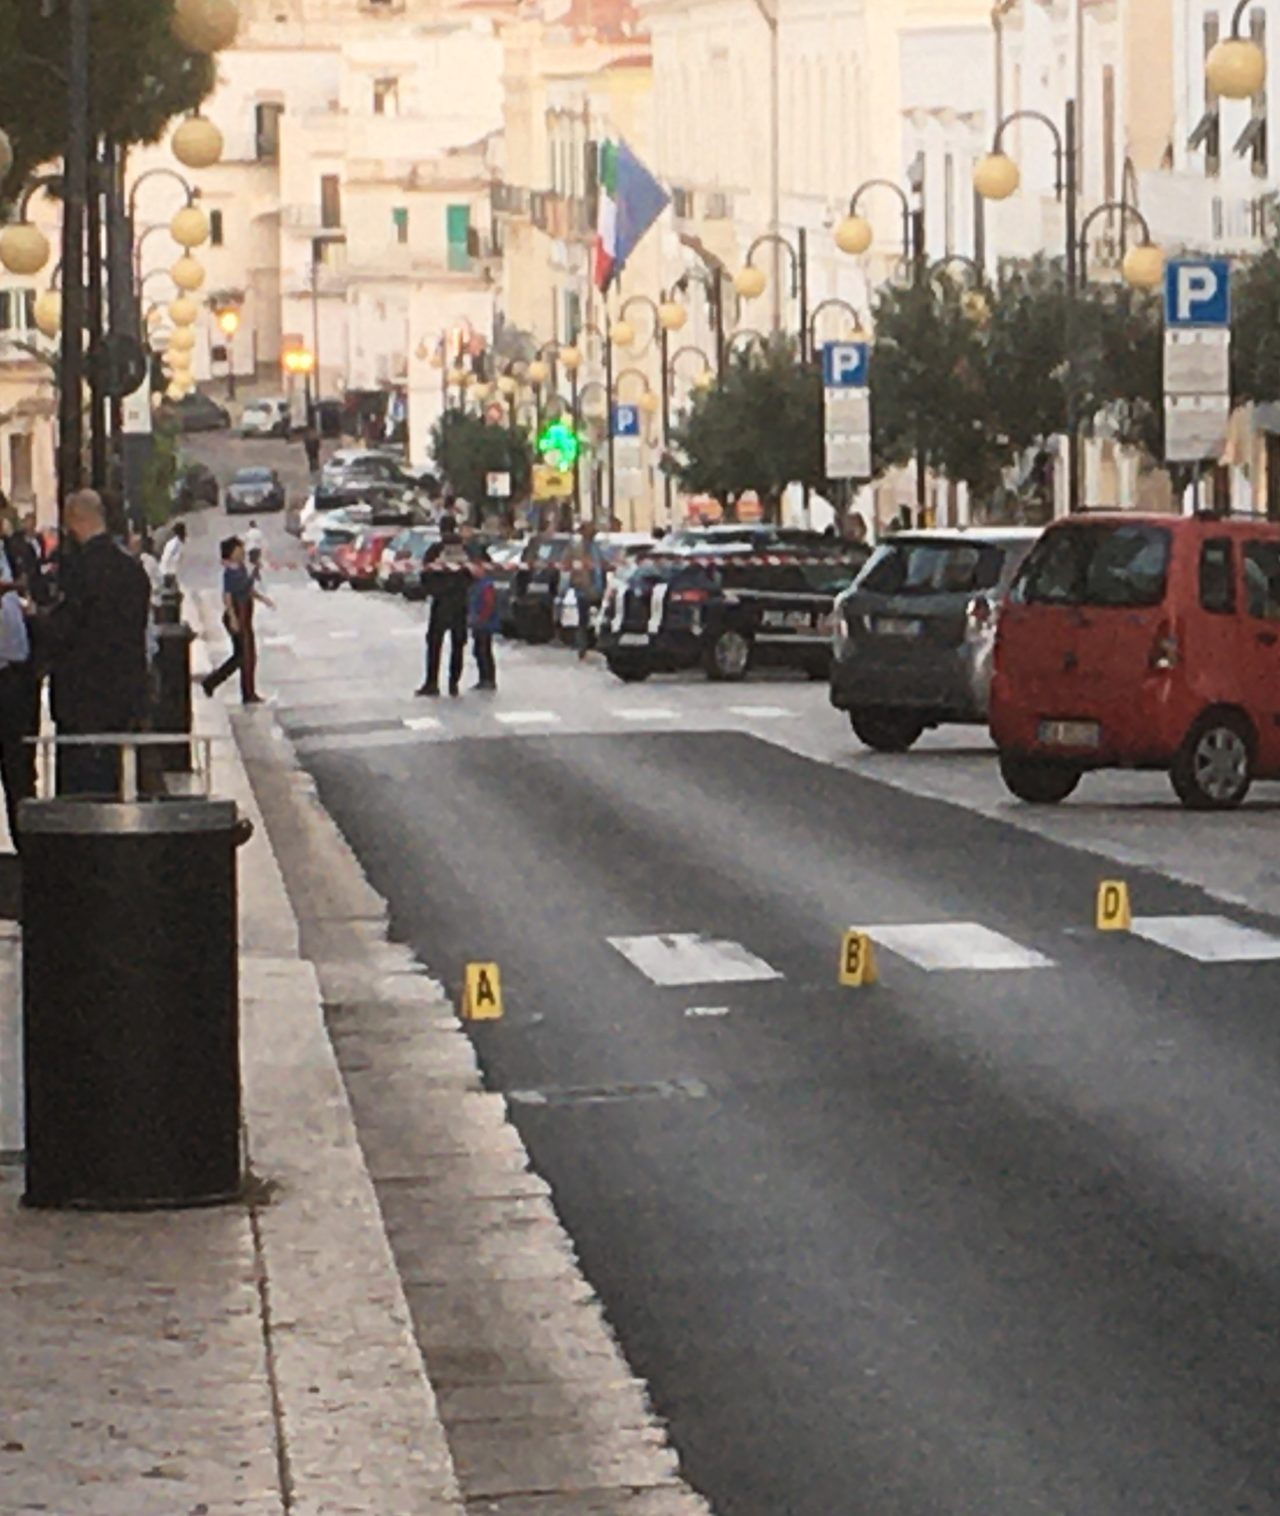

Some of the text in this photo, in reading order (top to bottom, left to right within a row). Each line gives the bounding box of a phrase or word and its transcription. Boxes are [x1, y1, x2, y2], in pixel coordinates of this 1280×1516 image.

[1177, 266, 1217, 319] P
[832, 347, 860, 382] P
[618, 408, 633, 431] P
[1104, 886, 1119, 920] D
[846, 938, 861, 973] B
[476, 969, 496, 1006] A
